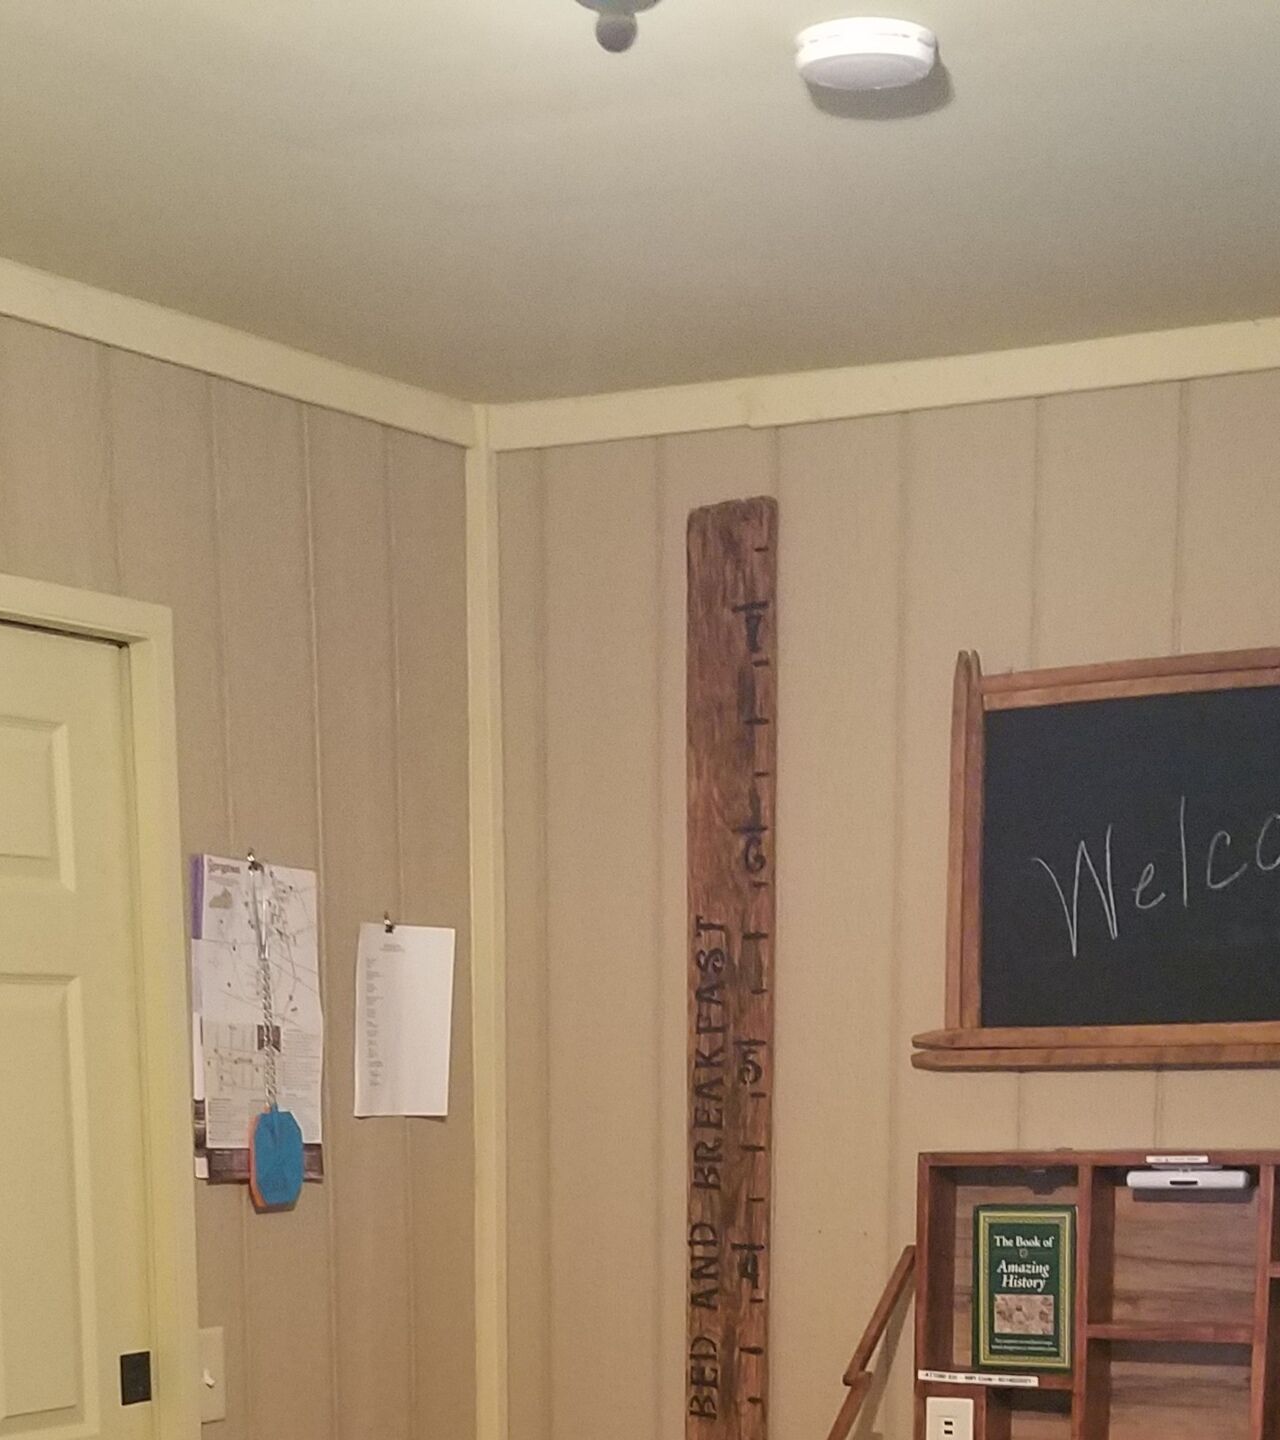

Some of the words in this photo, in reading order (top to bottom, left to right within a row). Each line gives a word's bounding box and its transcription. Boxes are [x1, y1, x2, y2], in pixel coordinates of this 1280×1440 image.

[692, 915, 728, 1191] BREAKFAST
[741, 1047, 763, 1085] 5
[994, 1235, 1013, 1247] The
[1016, 1235, 1041, 1247] Book
[1043, 1235, 1055, 1248] of
[687, 1221, 720, 1311] AND
[997, 1260, 1050, 1278] Amazing
[1002, 1274, 1046, 1293] History
[688, 1335, 719, 1421] BED
